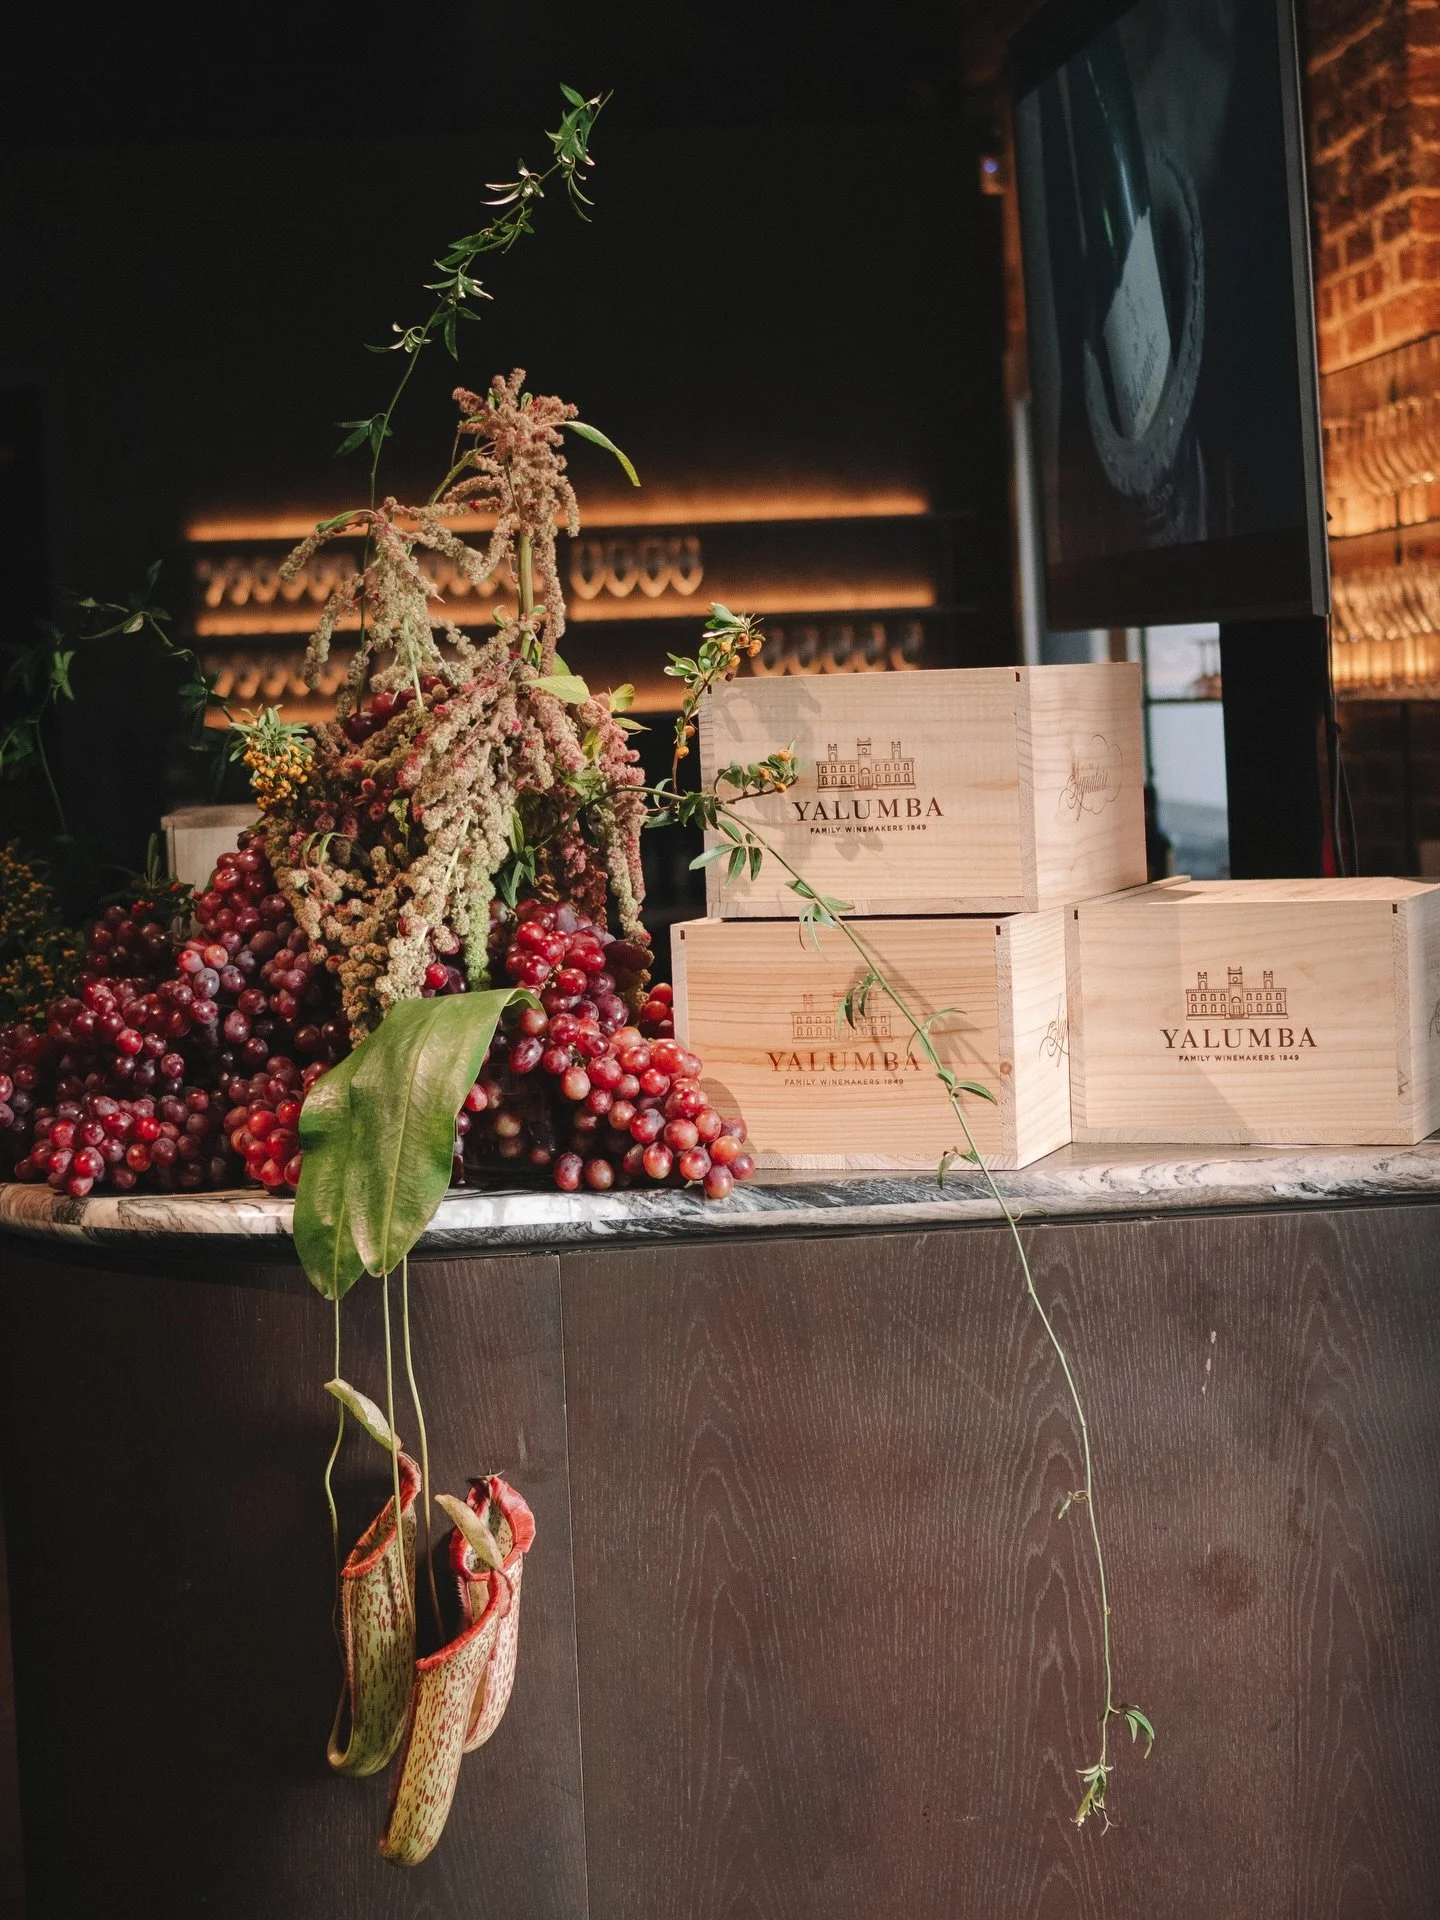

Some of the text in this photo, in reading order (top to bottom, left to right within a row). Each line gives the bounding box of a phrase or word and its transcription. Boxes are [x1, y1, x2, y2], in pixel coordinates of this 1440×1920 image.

[791, 796, 944, 822] YALUMBA
[810, 826, 841, 835] FAMILY
[845, 824, 903, 833] WINEMAKERS
[1159, 1027, 1318, 1049] YALUMBA
[765, 1050, 922, 1072] YALUMBA
[1214, 1054, 1275, 1062] WINEMAKERS
[784, 1078, 816, 1086] FAMILY
[819, 1078, 880, 1086] WINEMAKERS
